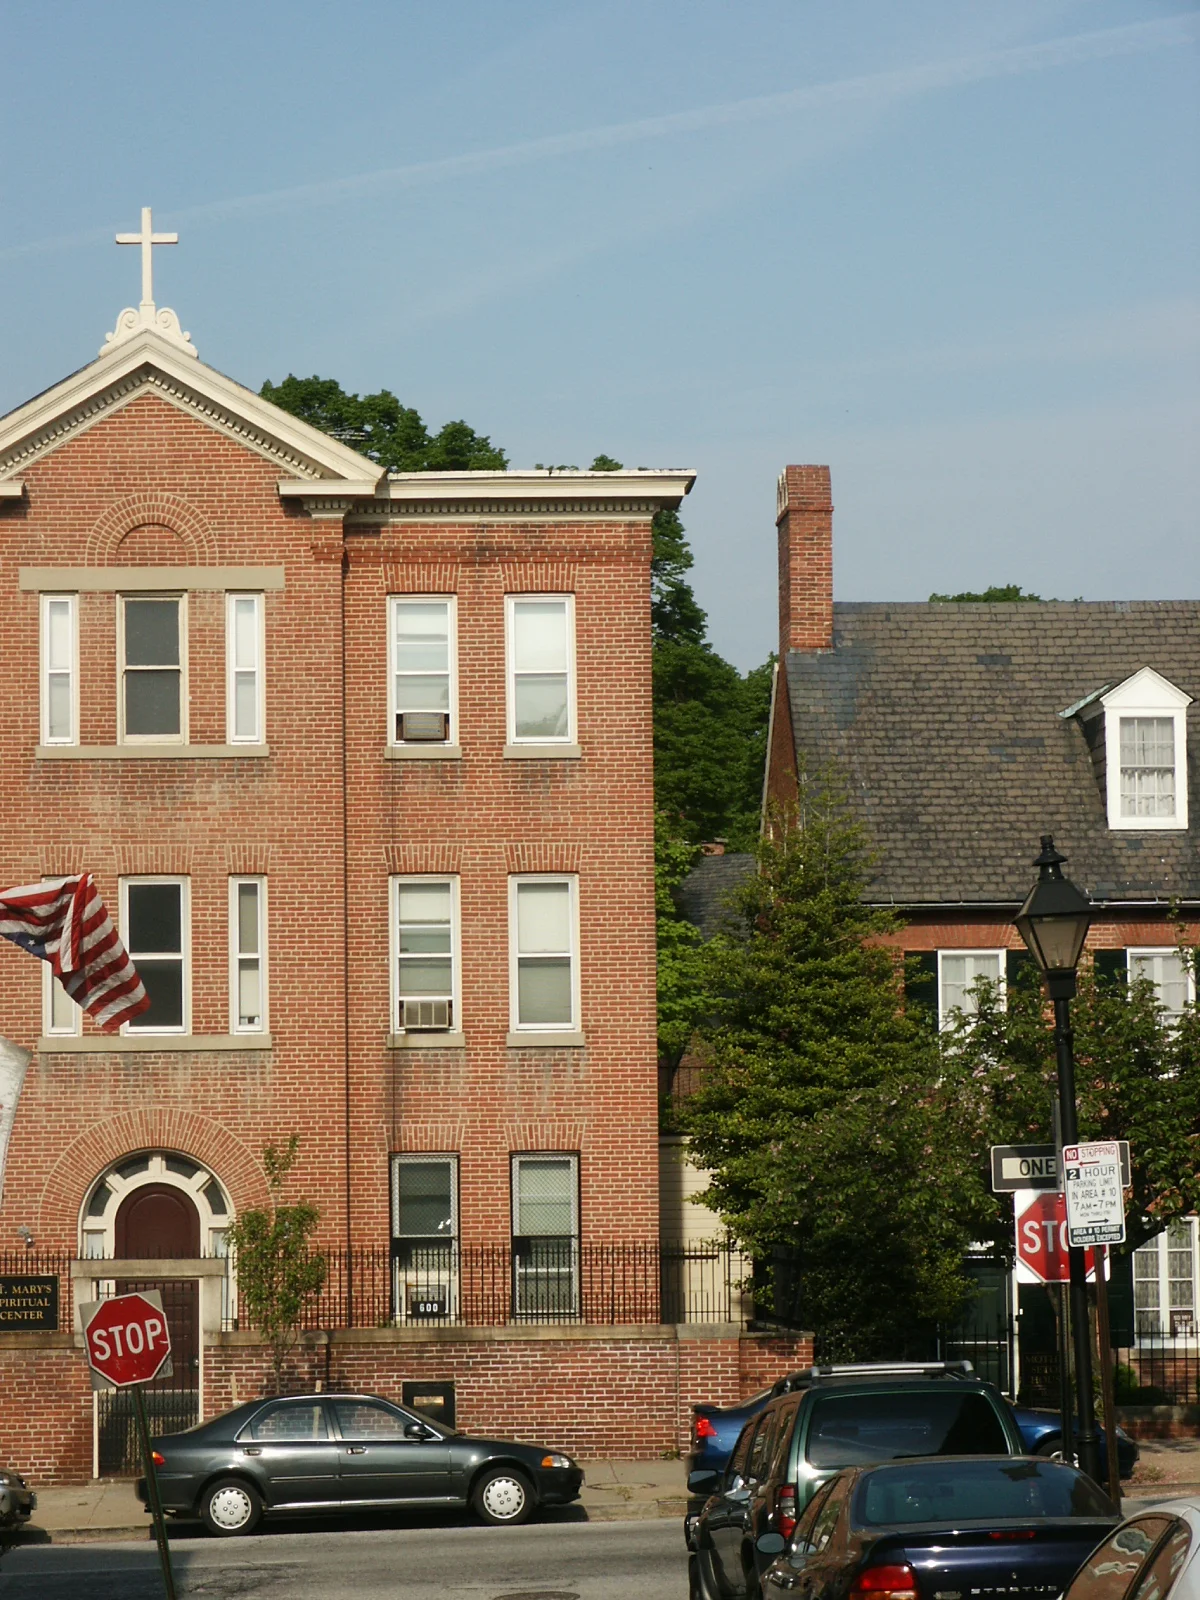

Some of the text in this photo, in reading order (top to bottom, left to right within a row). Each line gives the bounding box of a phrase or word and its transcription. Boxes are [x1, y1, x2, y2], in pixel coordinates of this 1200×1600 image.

[1066, 1146, 1115, 1160] NO STOPPING
[1020, 1158, 1056, 1177] ONE
[1069, 1166, 1115, 1179] 2 HOUR
[1073, 1177, 1113, 1188] PARKING LIMIT
[1072, 1191, 1079, 1200] IN
[1081, 1189, 1098, 1199] AREA
[12, 1284, 52, 1294] MARY'S
[419, 1303, 438, 1312] 600
[0, 1310, 44, 1320] CENTER
[92, 1318, 162, 1361] STOP
[970, 1585, 1057, 1595] STRATUS
